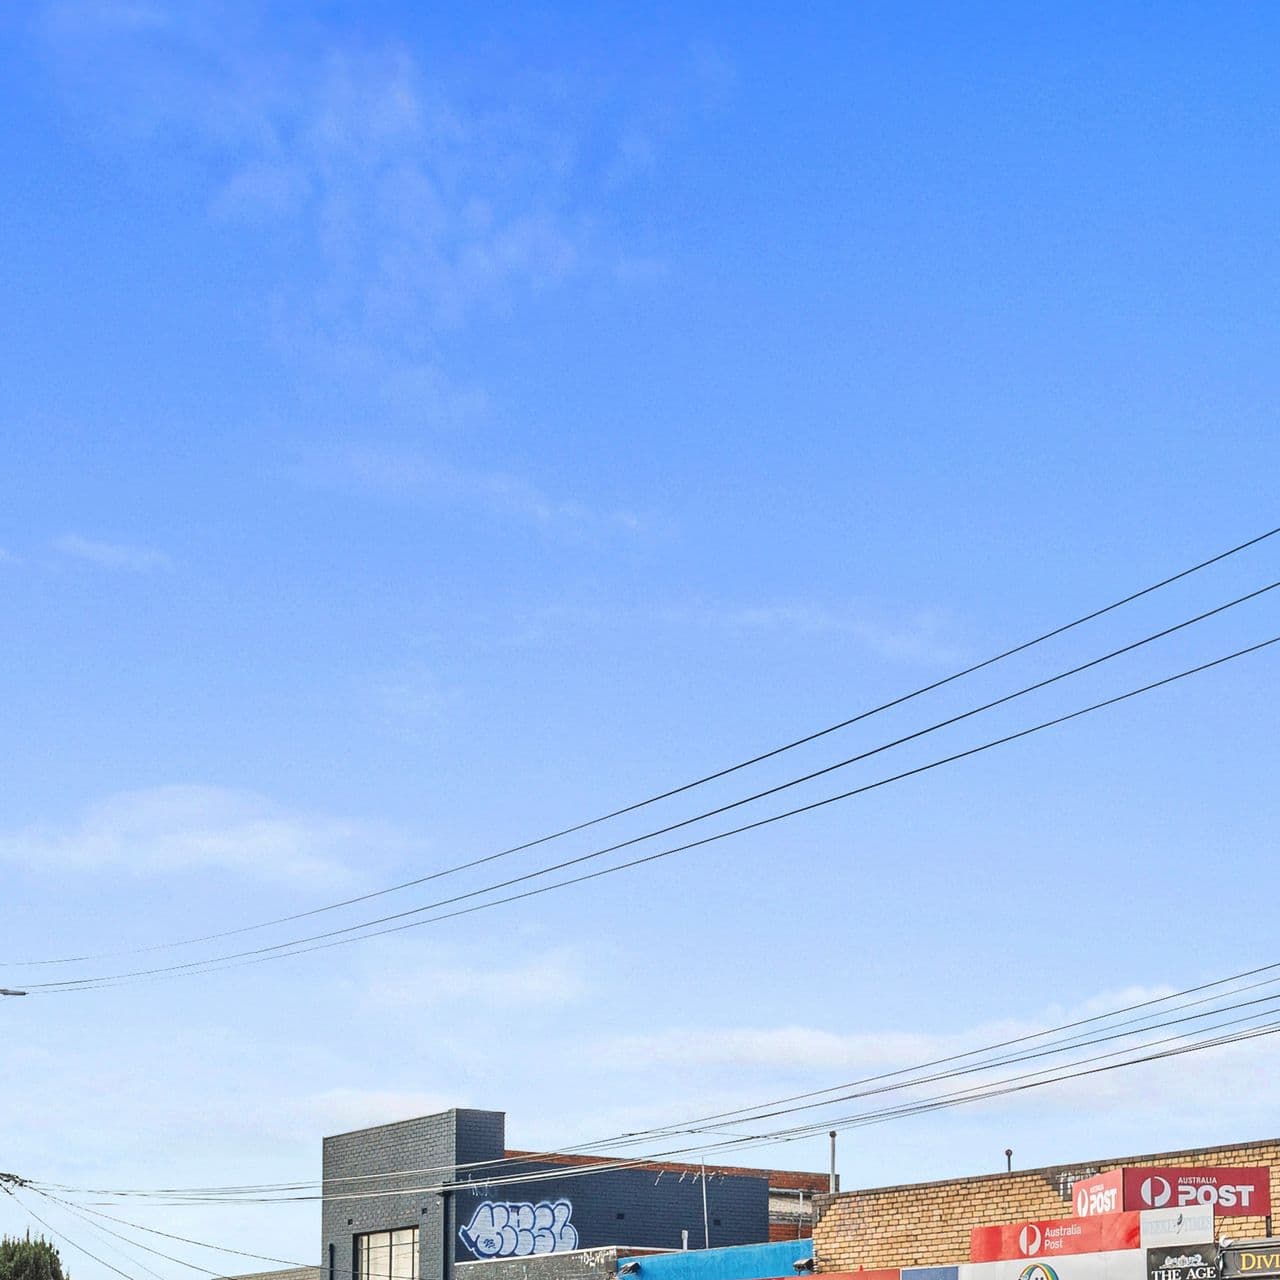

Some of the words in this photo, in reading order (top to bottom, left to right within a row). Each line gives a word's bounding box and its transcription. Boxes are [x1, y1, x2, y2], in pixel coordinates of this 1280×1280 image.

[1177, 1176, 1217, 1185] AUSTRALIA
[1089, 1187, 1117, 1216] POST
[1177, 1184, 1255, 1207] POST
[1044, 1226, 1082, 1237] Australia
[1044, 1239, 1063, 1250] Post
[1185, 1266, 1216, 1280] AGE
